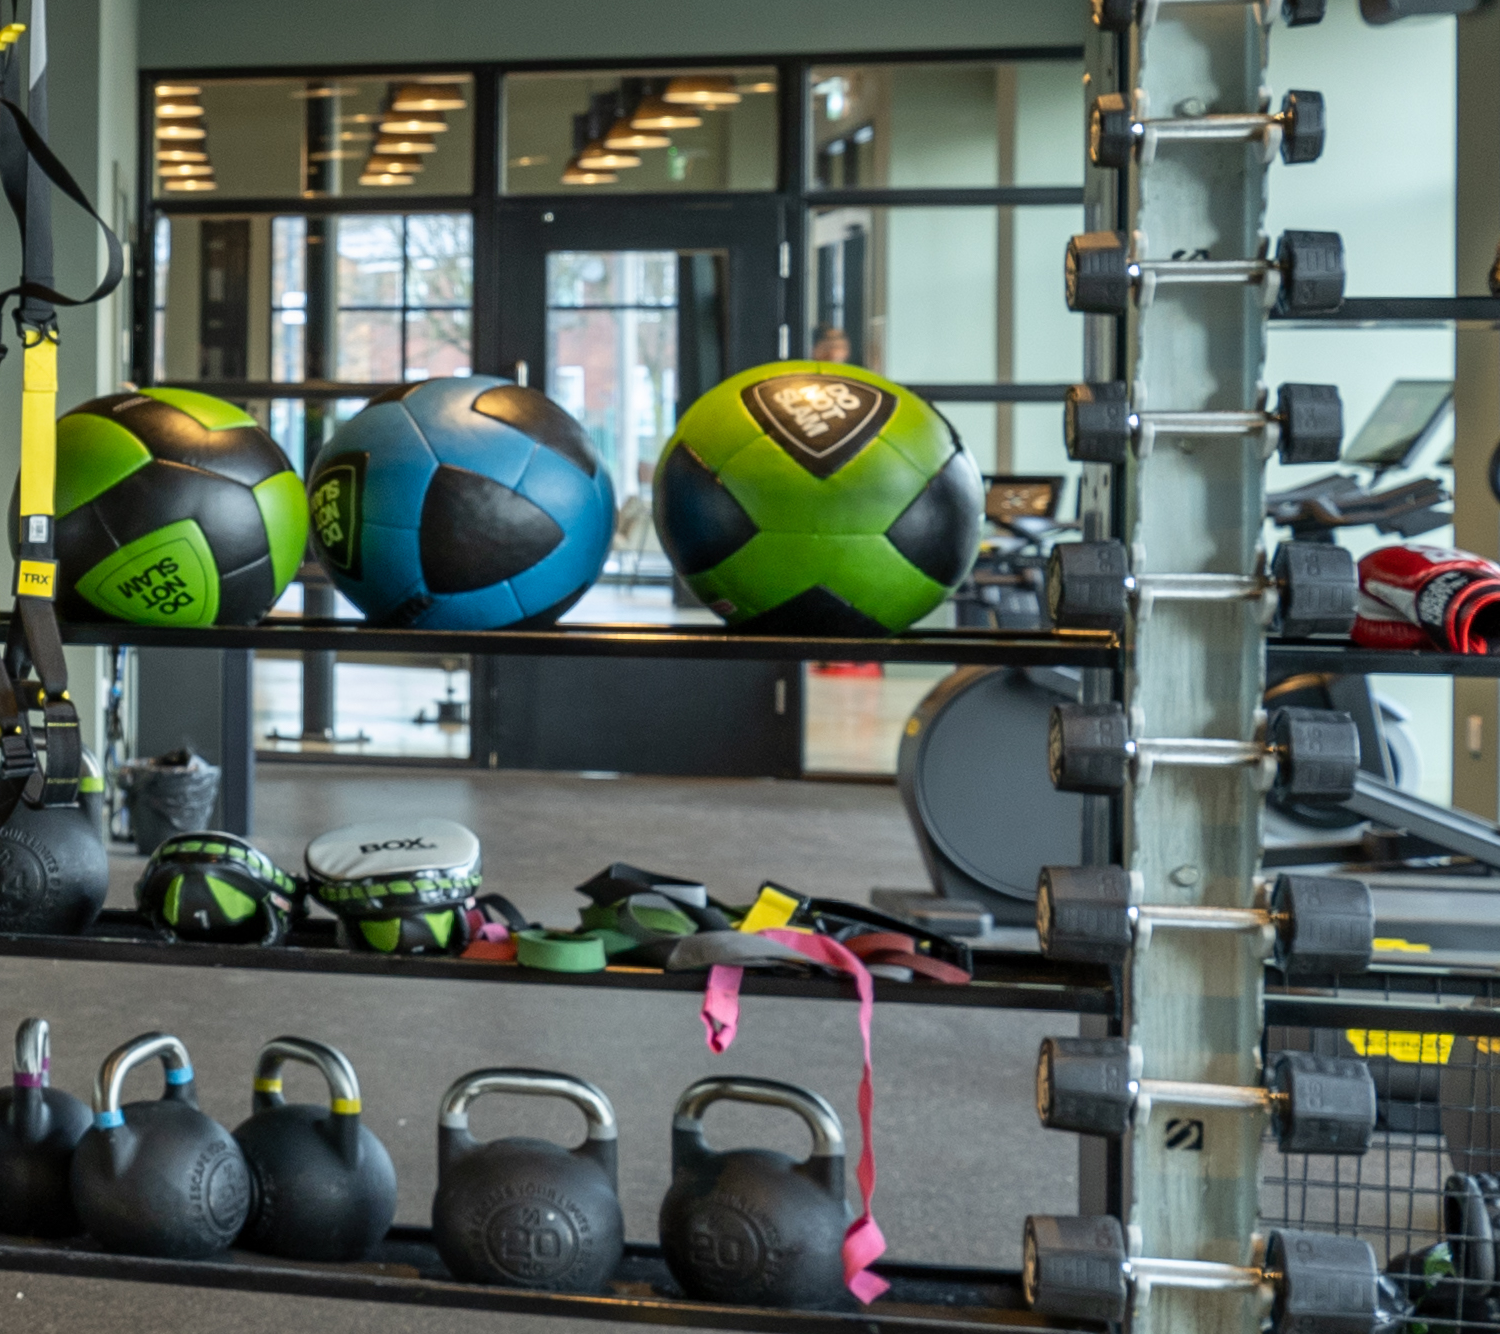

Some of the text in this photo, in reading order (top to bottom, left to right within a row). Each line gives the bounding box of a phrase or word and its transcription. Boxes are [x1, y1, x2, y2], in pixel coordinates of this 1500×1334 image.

[824, 382, 862, 411] DO
[772, 387, 831, 439] SLAM
[23, 572, 50, 586] TRX
[117, 556, 179, 599] SLAM
[141, 574, 187, 610] NOT
[158, 592, 195, 616] DO
[359, 836, 427, 855] BOX
